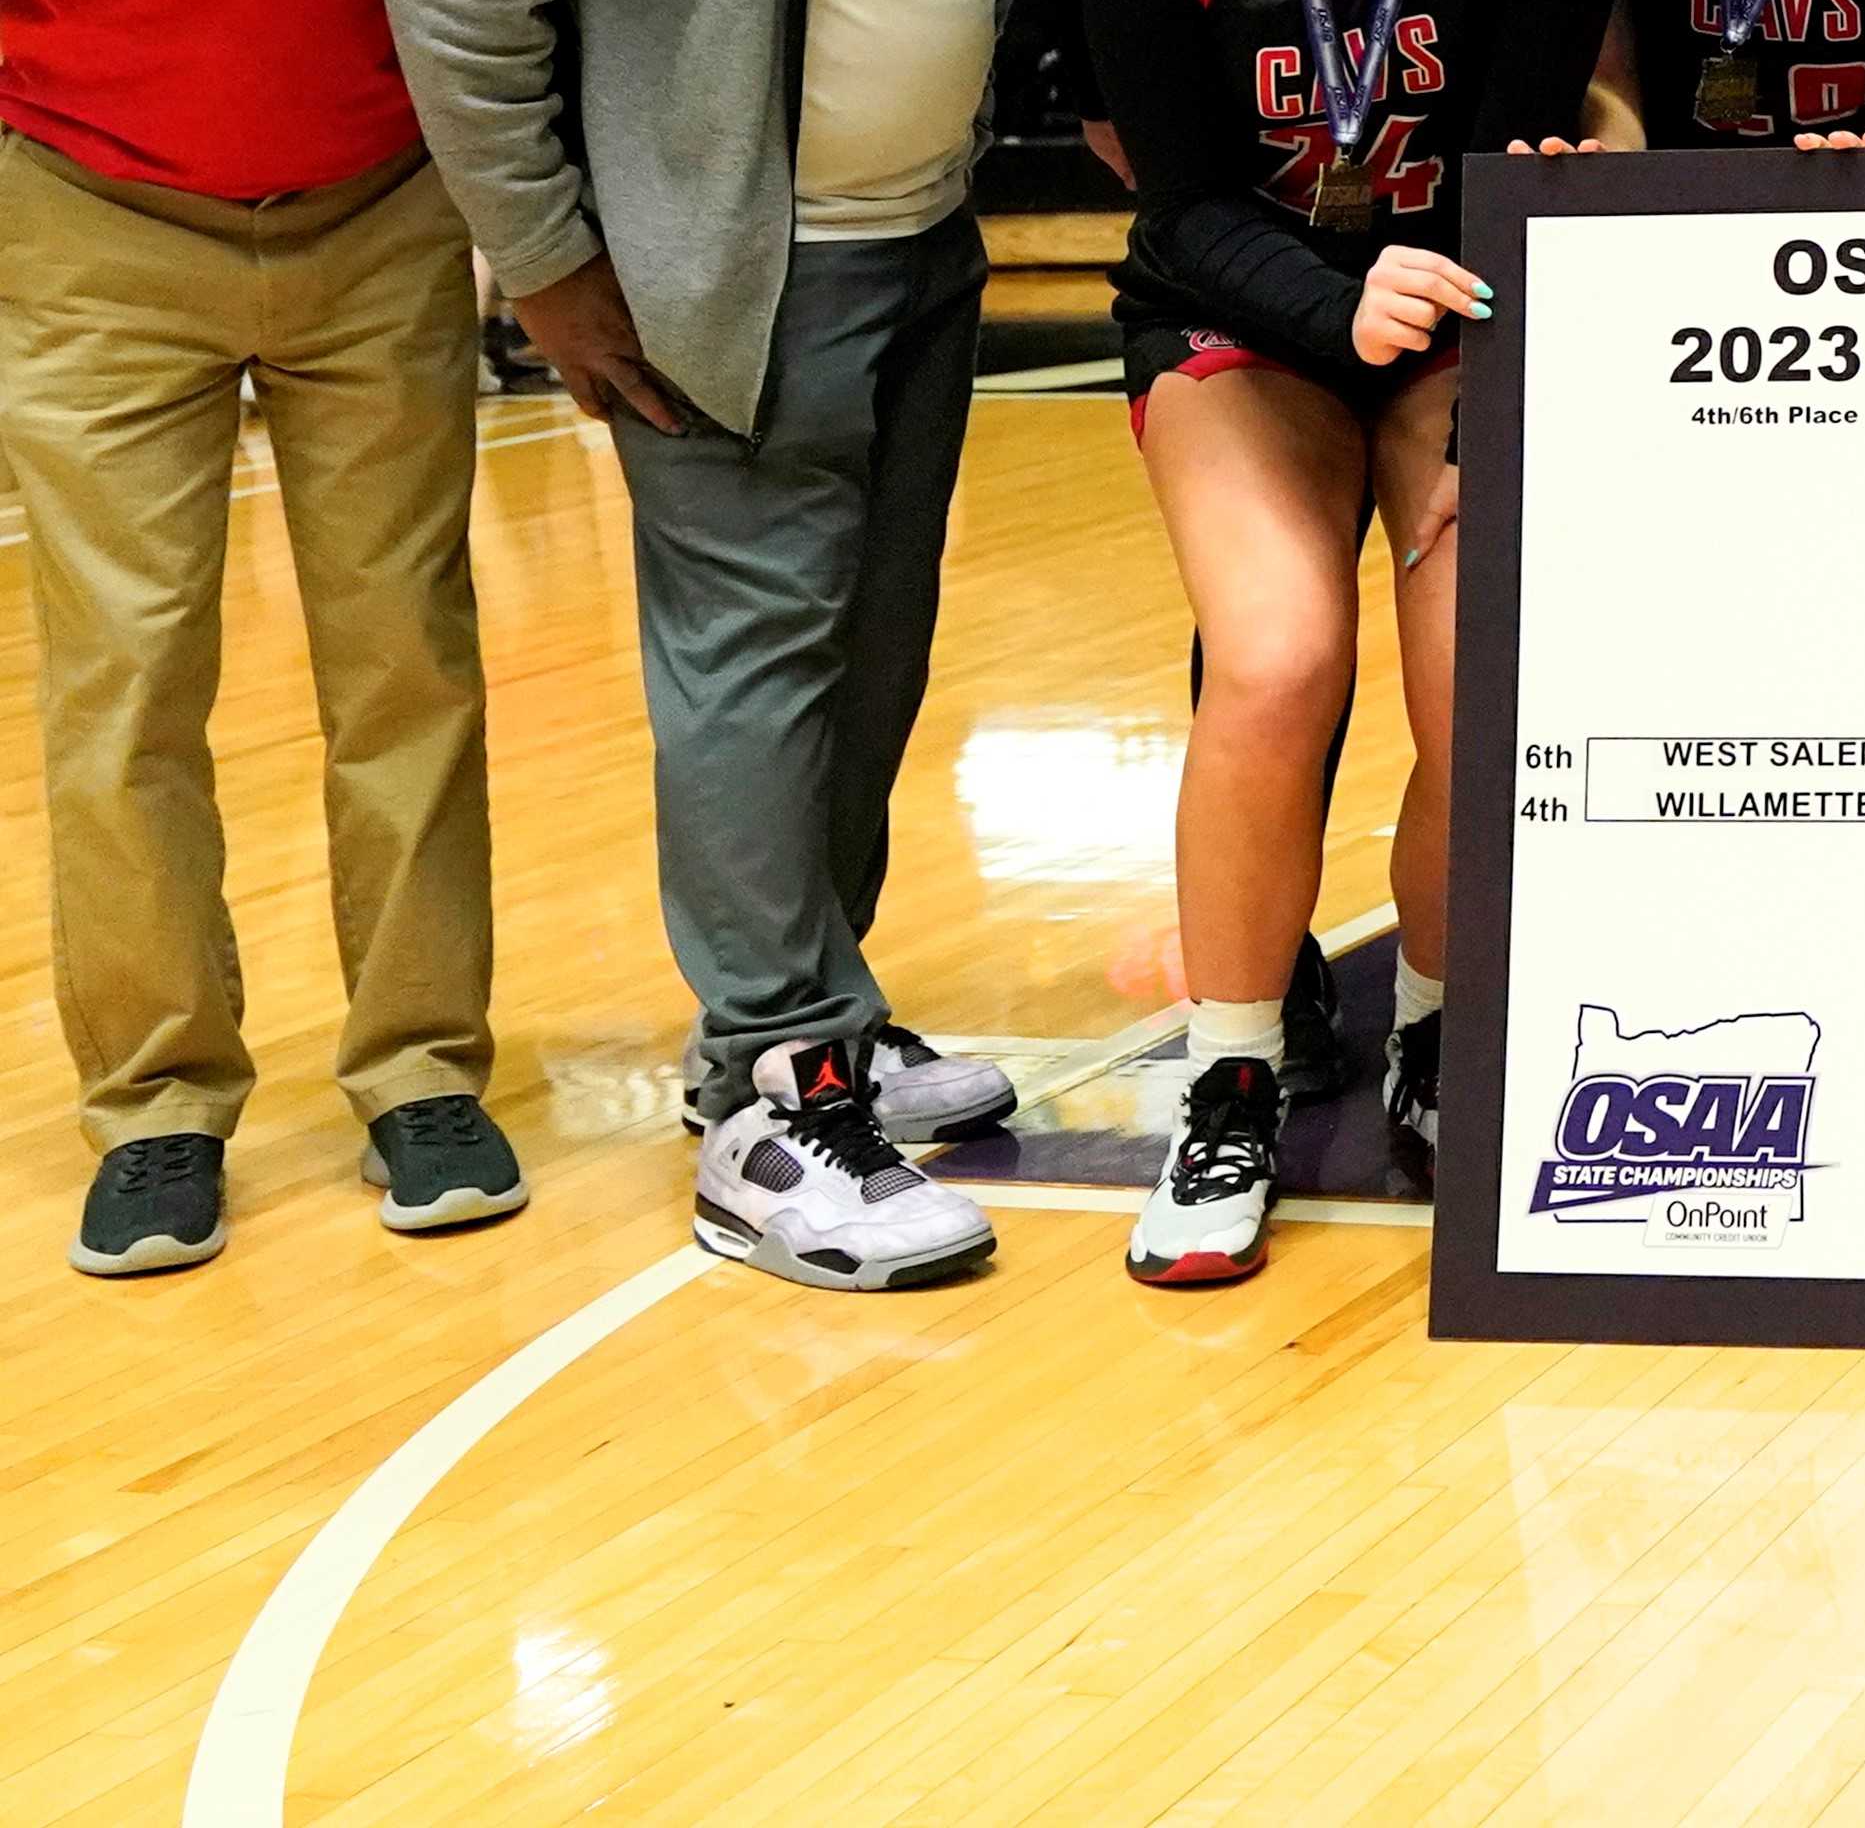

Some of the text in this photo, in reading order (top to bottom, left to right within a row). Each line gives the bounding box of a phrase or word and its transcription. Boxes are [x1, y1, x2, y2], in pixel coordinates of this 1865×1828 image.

[1670, 326, 1860, 382] 2023
[1692, 406, 1857, 425] 4th/6th Place
[1526, 745, 1571, 768] 6th
[1664, 742, 1757, 766] WEST
[1521, 797, 1567, 821] 4th
[1556, 1073, 1816, 1162] OSAA
[1553, 1164, 1799, 1189] STATE CHAMPIONSHIPS
[1666, 1200, 1768, 1229] OnPoint
